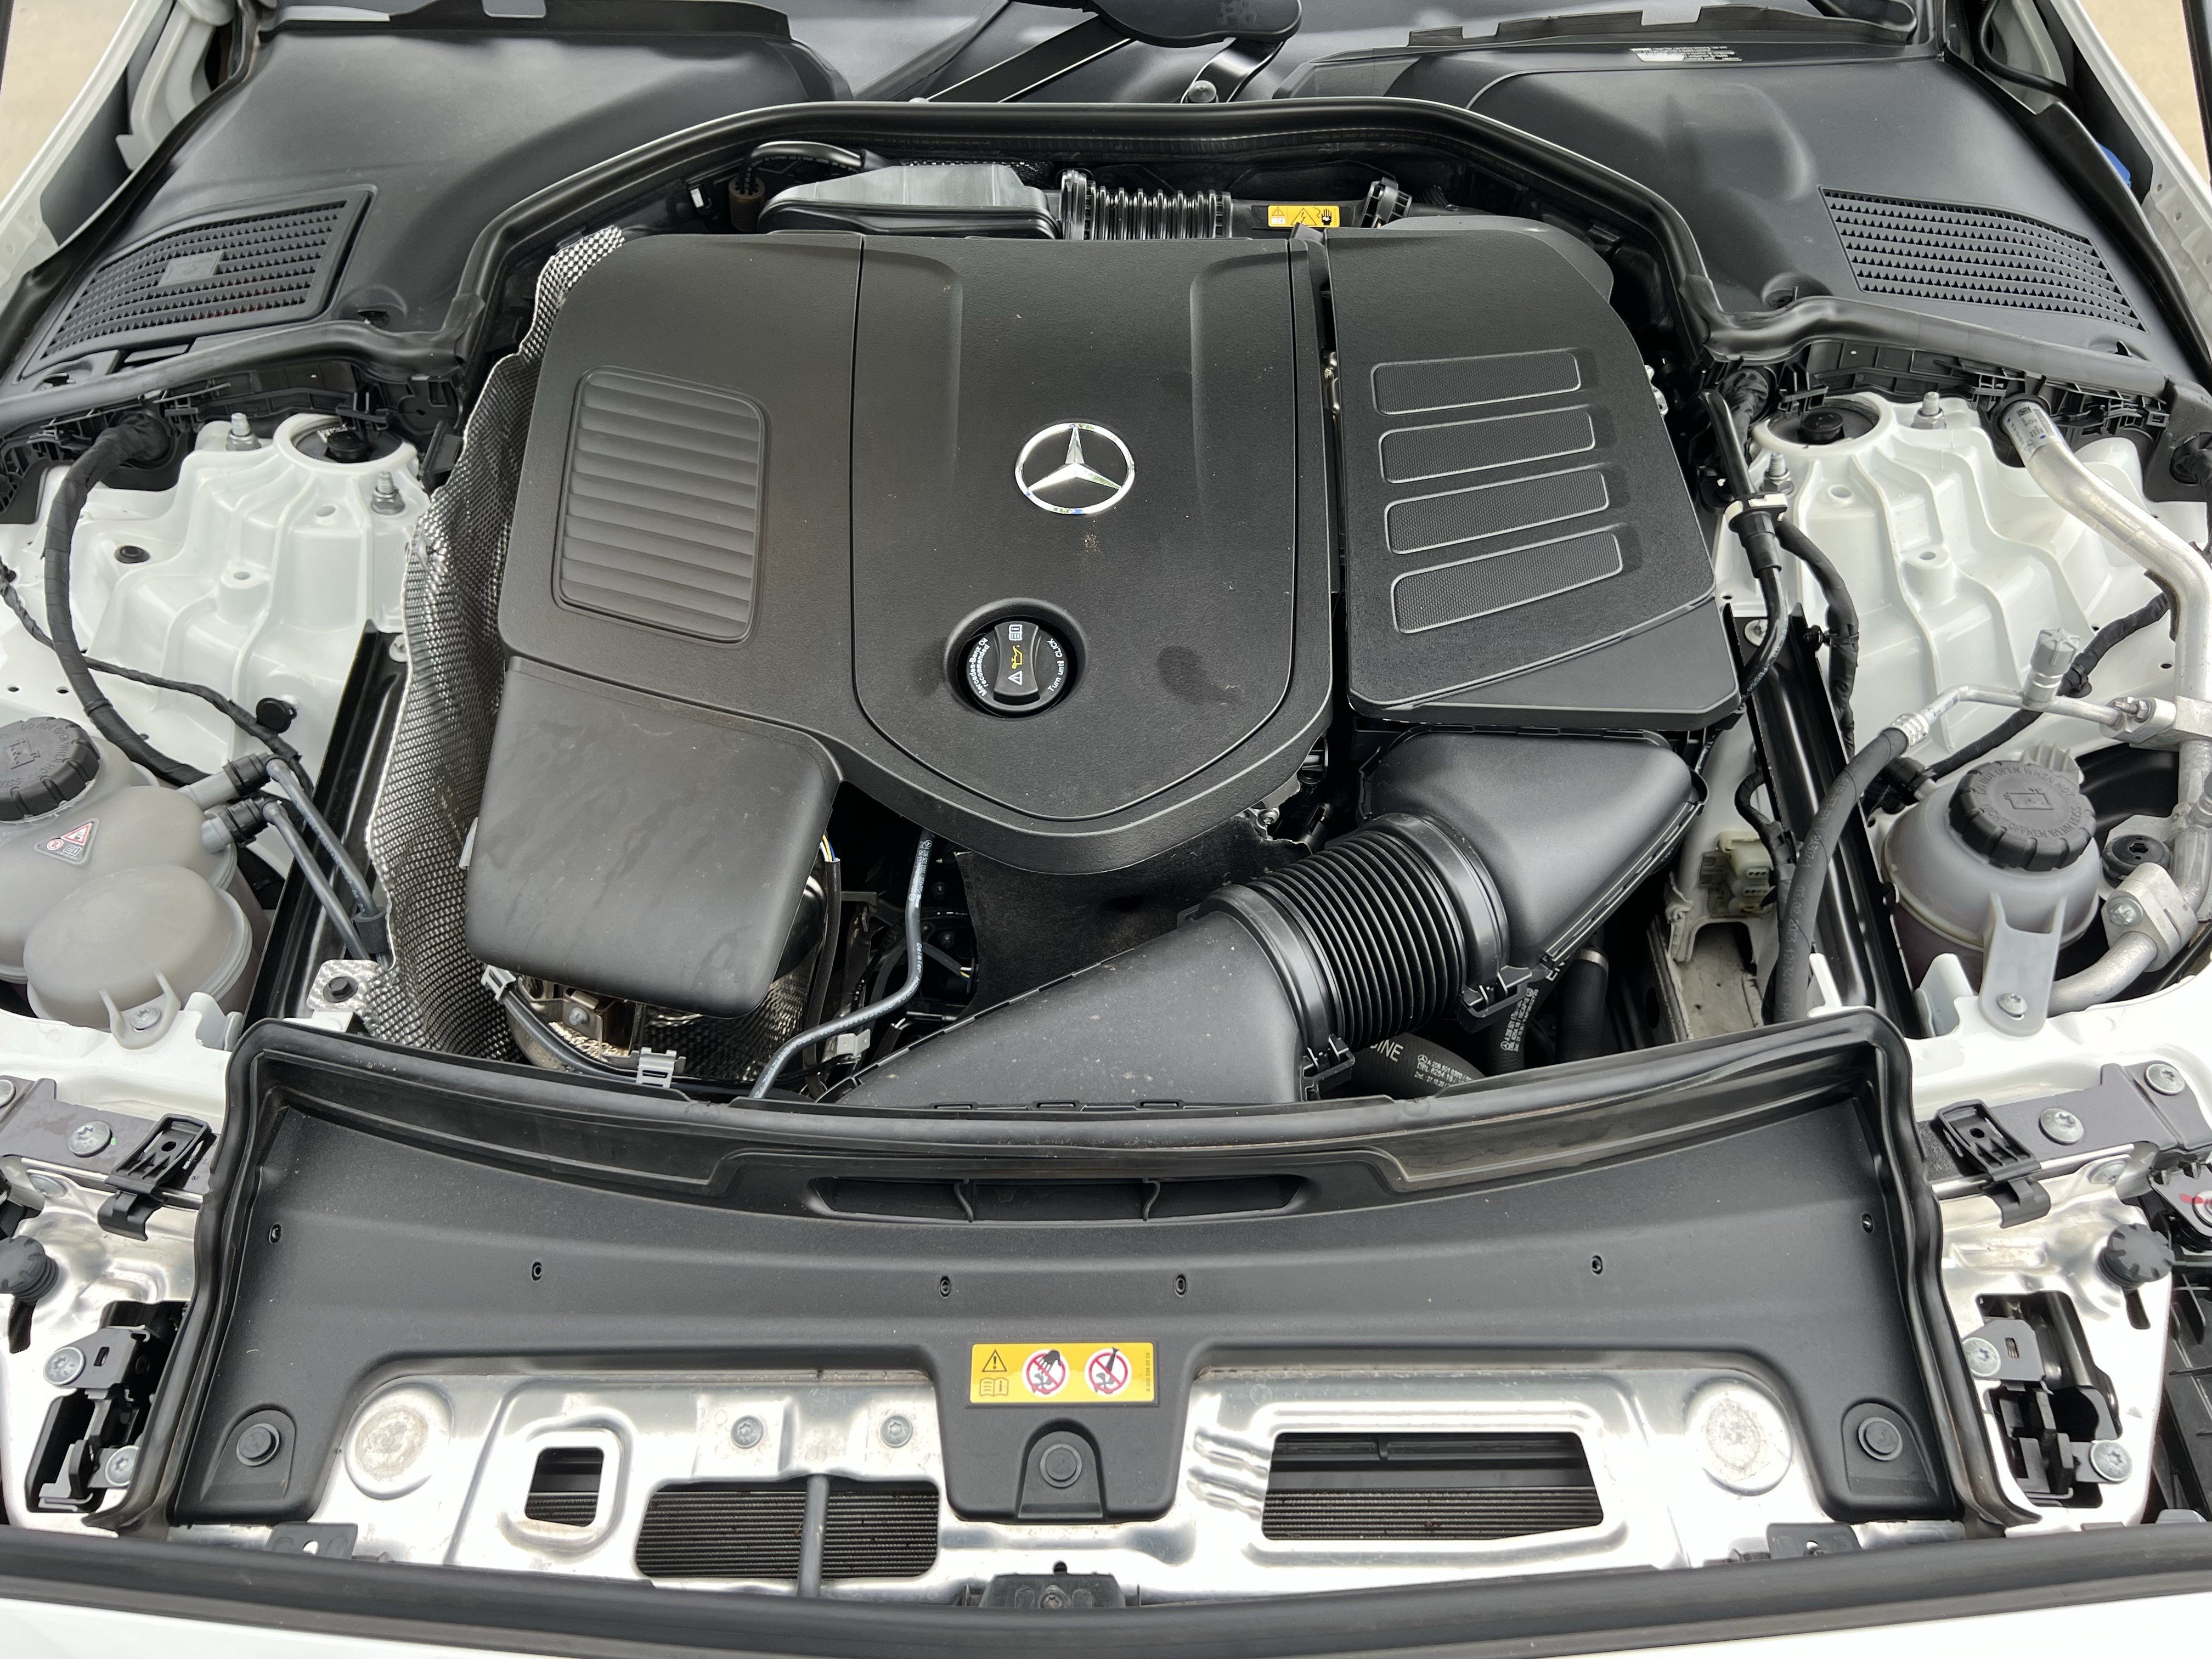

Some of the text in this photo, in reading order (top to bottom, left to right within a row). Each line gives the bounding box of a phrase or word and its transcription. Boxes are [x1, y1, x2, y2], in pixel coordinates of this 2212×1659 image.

[1047, 638, 1063, 657] CLICK
[969, 646, 987, 696] Mercedes-Benz
[977, 643, 990, 687] recommended
[1047, 677, 1061, 691] Turn
[2024, 768, 2054, 783] WHEN
[1370, 1039, 1403, 1062] INE
